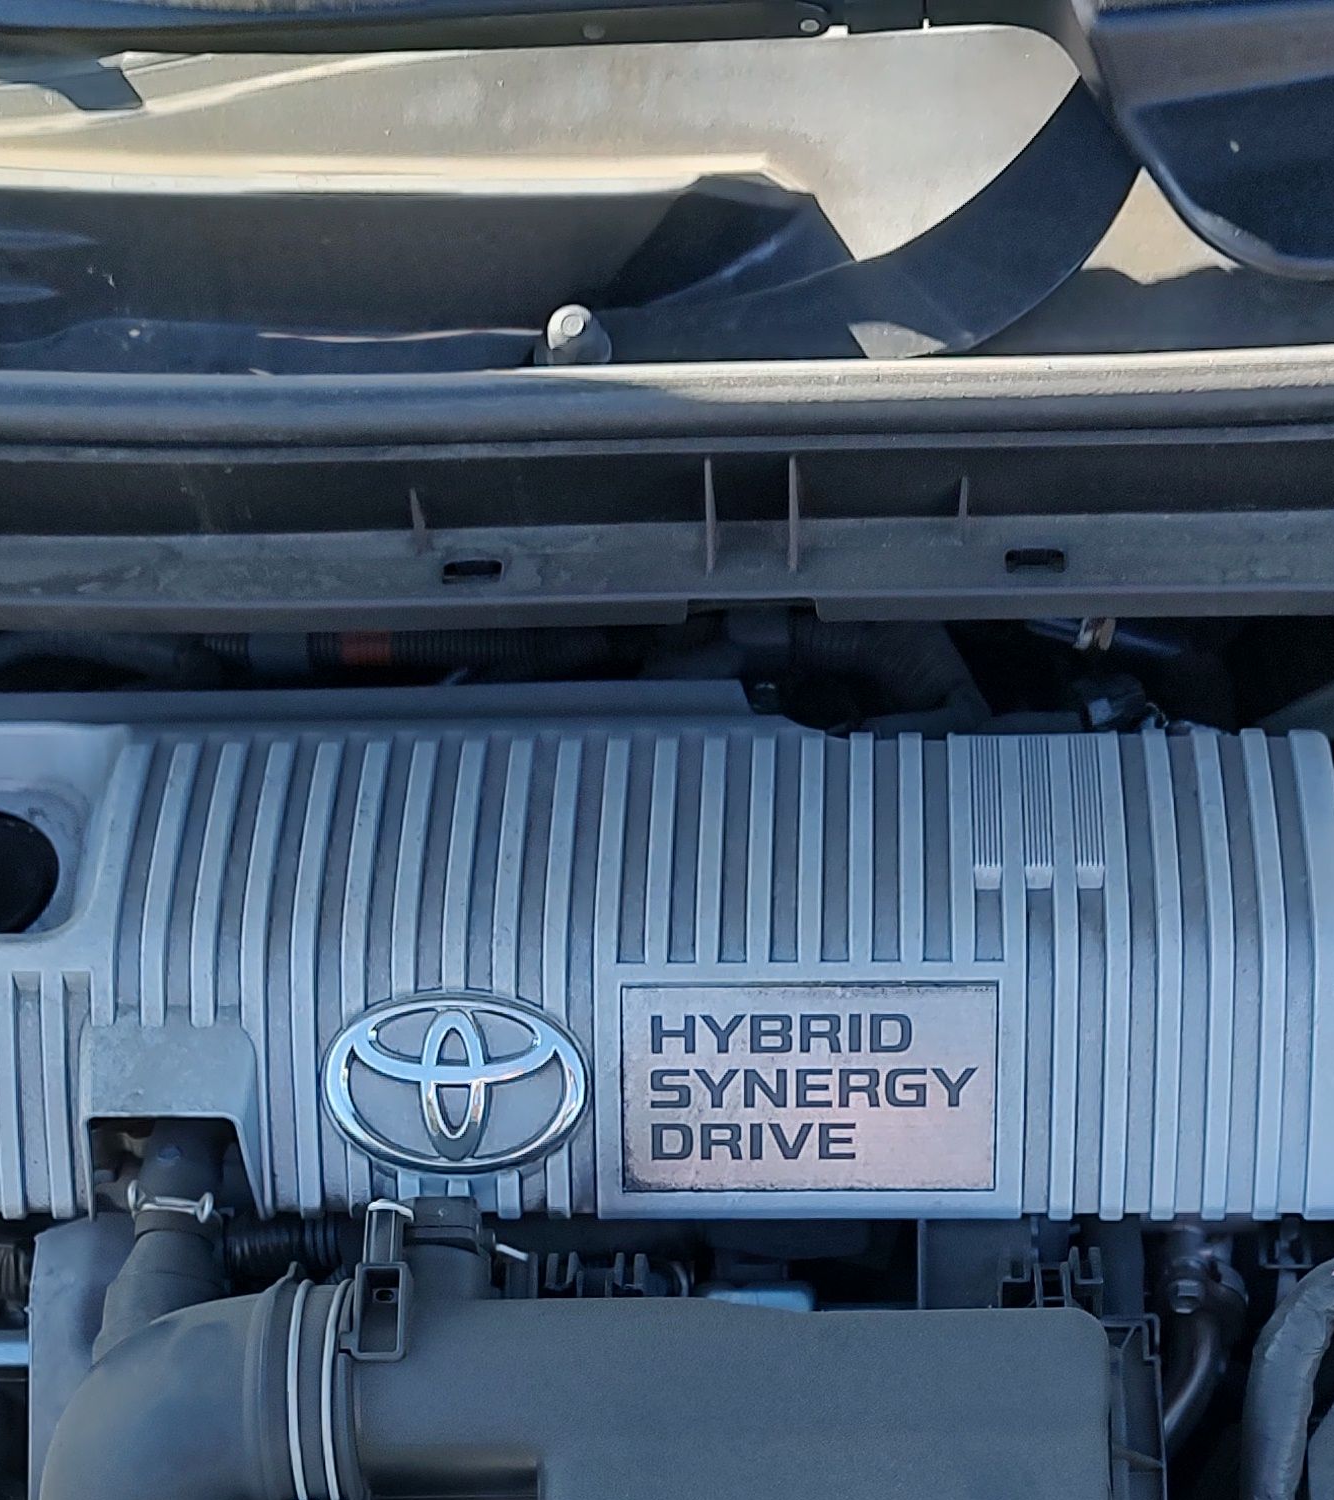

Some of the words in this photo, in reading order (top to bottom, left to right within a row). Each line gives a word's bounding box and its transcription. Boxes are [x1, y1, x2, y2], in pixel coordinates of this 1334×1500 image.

[651, 1013, 912, 1054] HYBRID
[651, 1067, 978, 1109] SYNERGY
[651, 1122, 857, 1161] DRIVE
